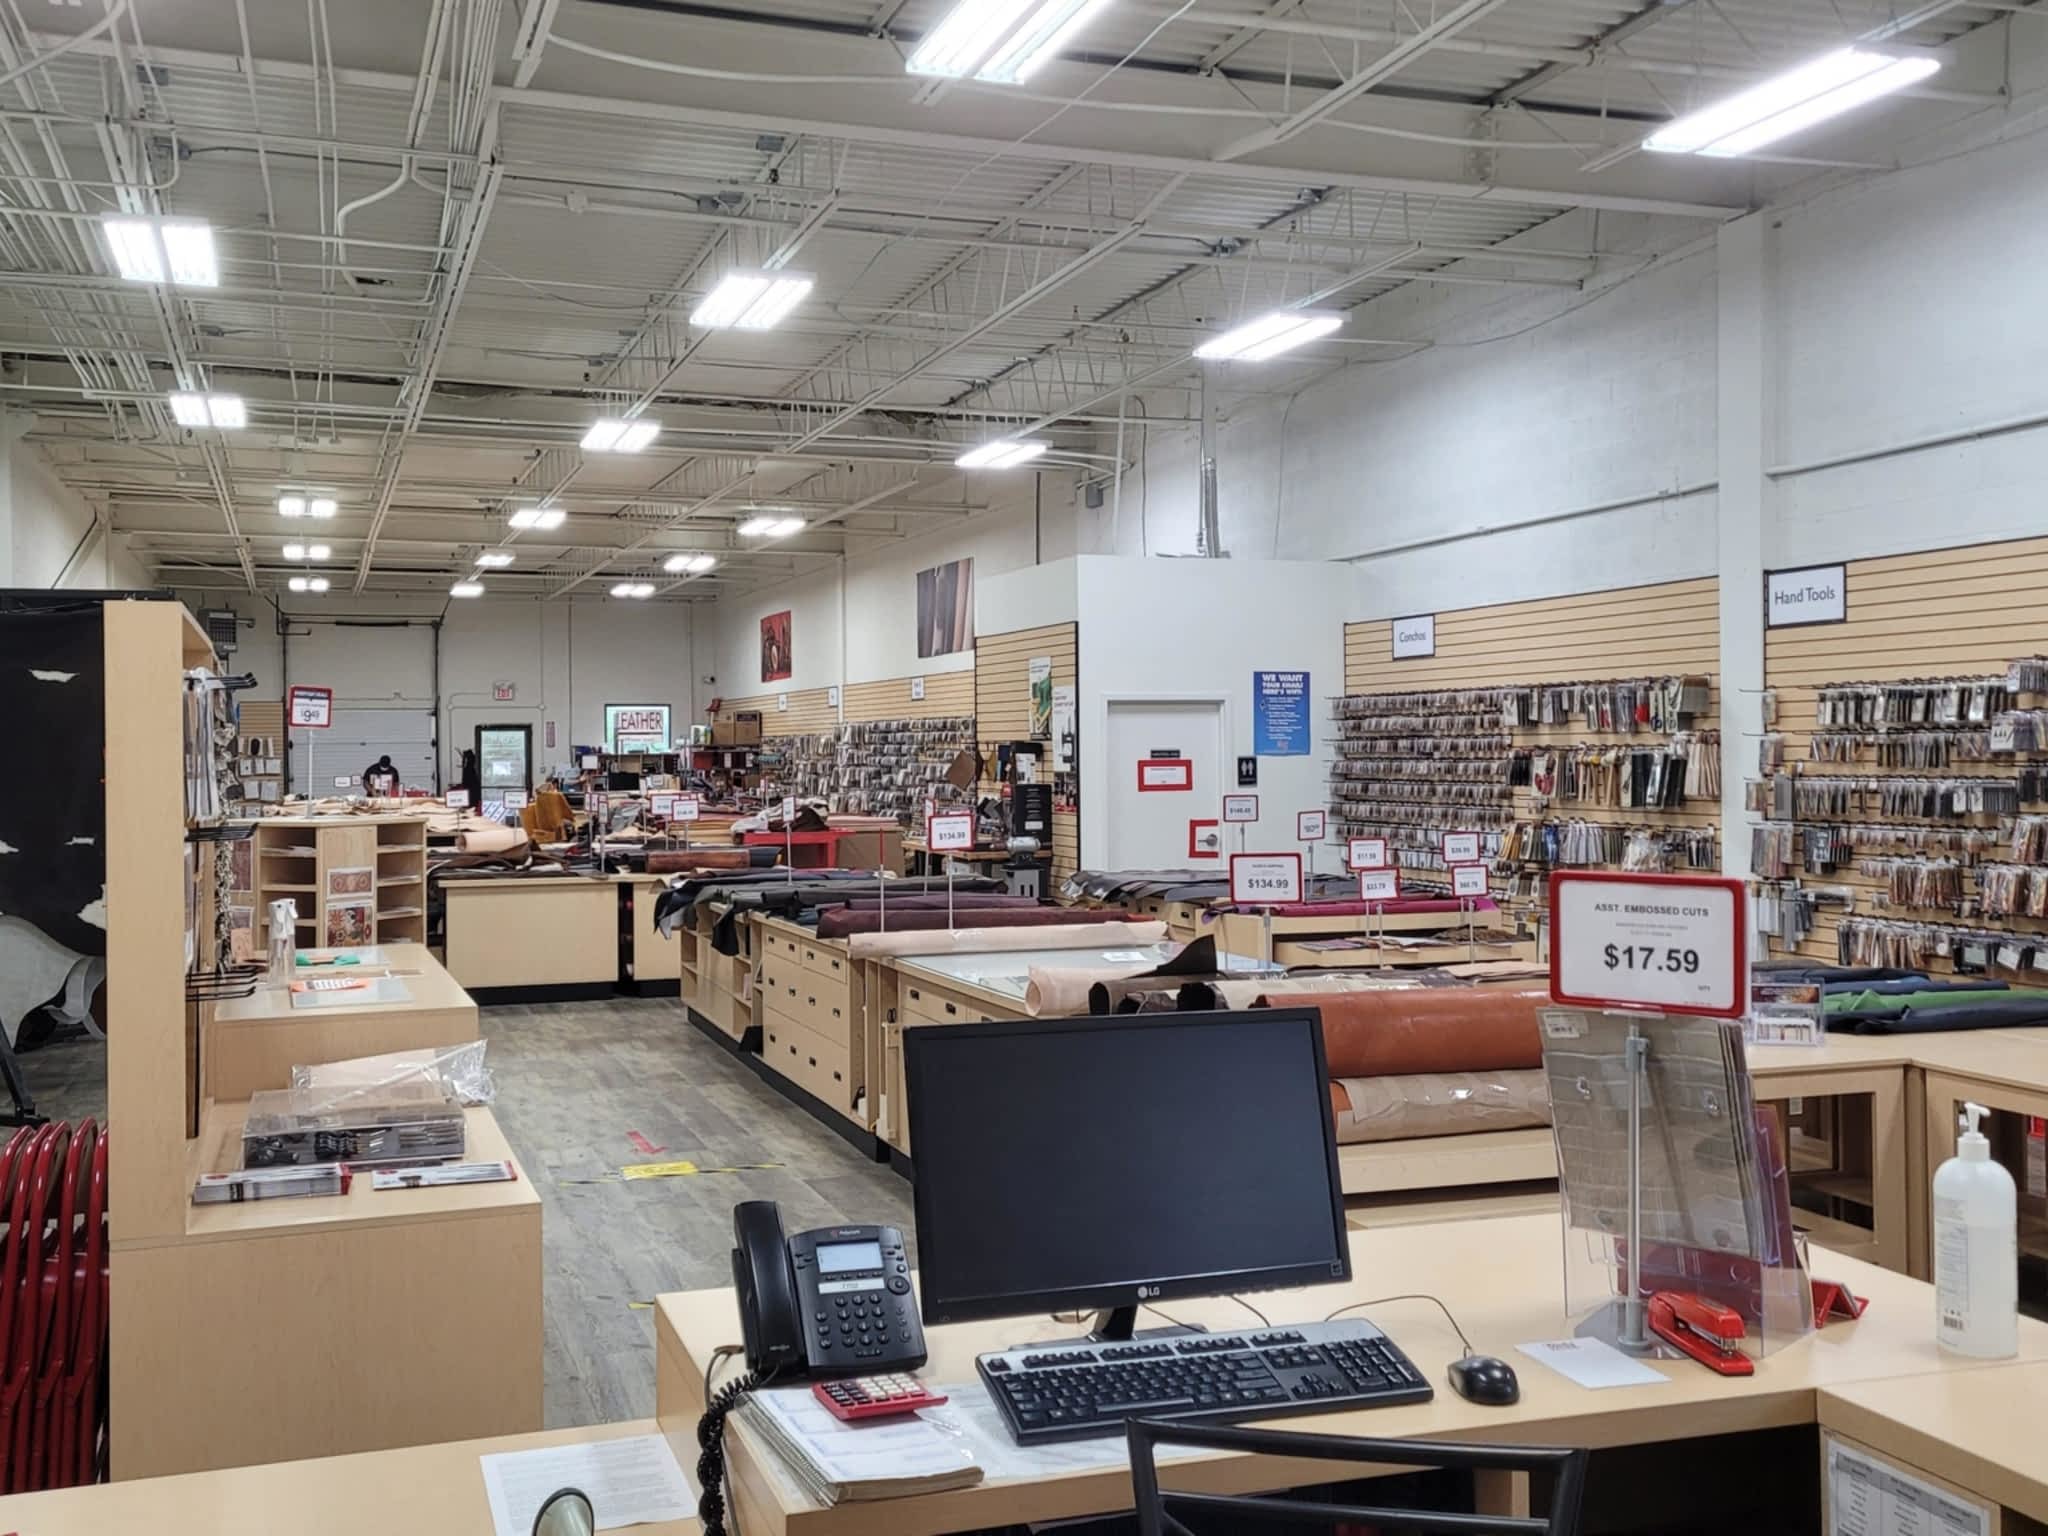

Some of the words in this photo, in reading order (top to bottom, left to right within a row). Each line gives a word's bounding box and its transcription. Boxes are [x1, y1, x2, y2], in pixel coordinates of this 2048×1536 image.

[1774, 588, 1804, 606] Hand
[1805, 585, 1836, 602] Tools
[1262, 673, 1277, 682] WE
[1278, 673, 1304, 682] WANT
[1247, 878, 1290, 890] $134.99
[1594, 903, 1621, 913] ASST.
[1624, 904, 1680, 916] EMBOSSED
[1681, 907, 1710, 918] CUTS
[1603, 942, 1700, 974] $17.59
[1148, 1286, 1161, 1297] LG
